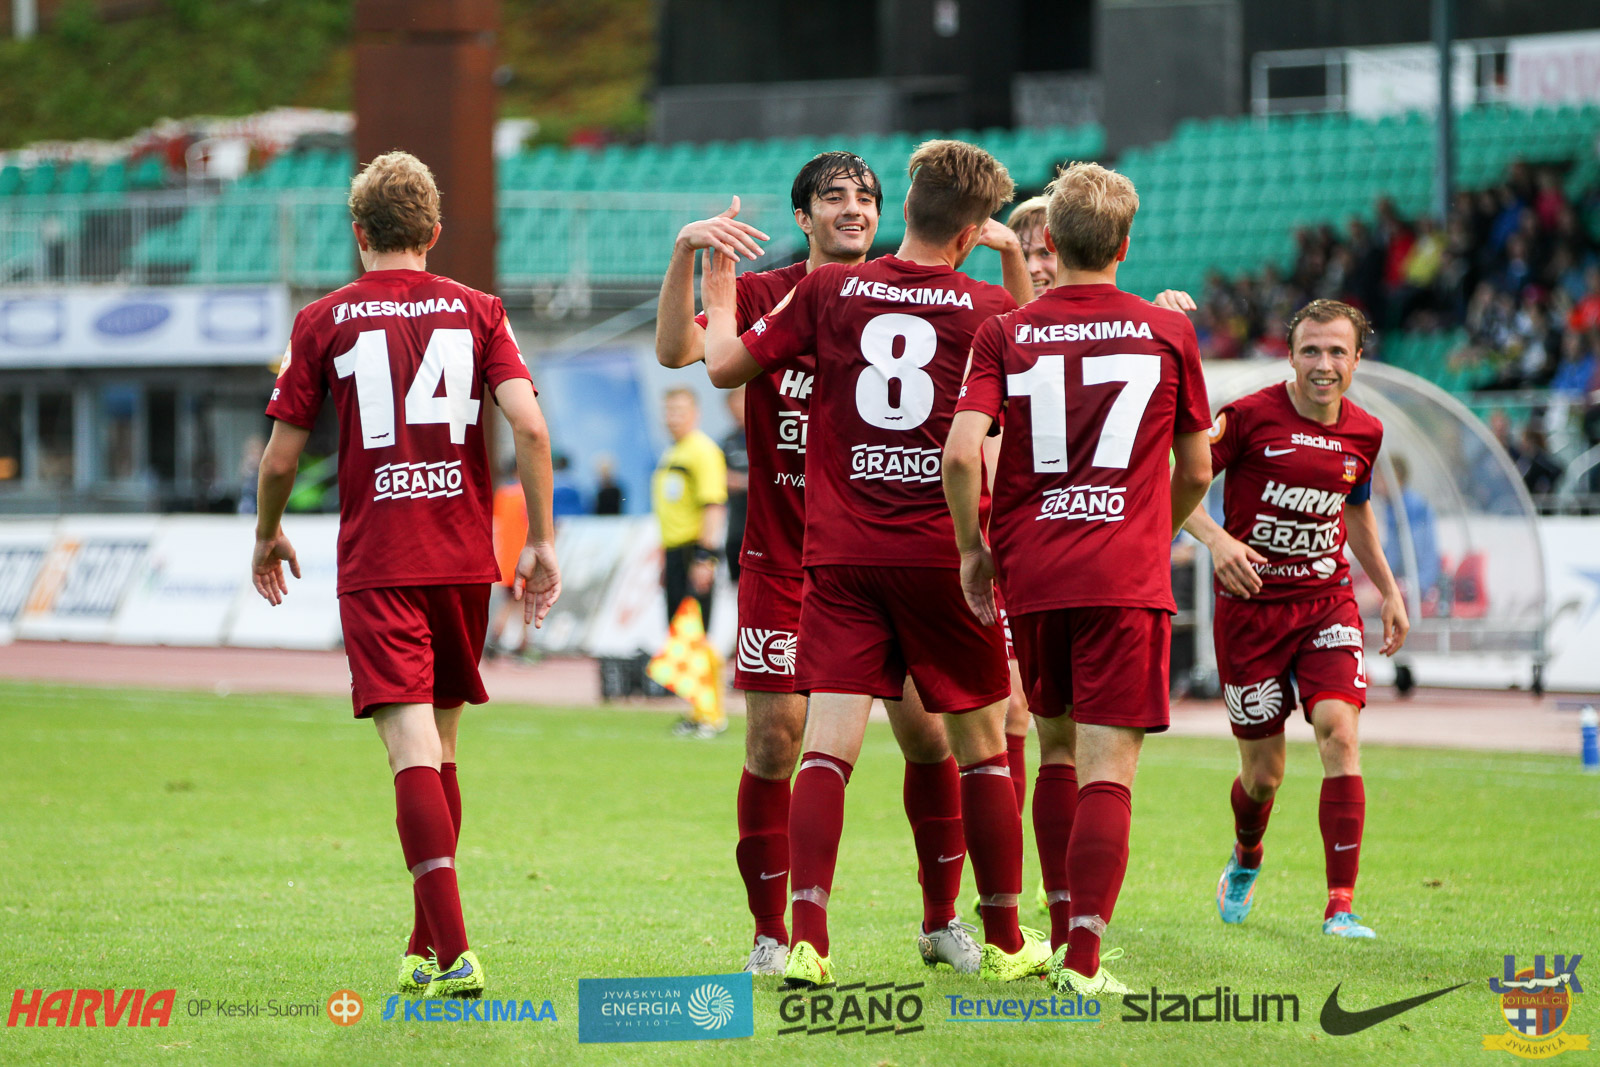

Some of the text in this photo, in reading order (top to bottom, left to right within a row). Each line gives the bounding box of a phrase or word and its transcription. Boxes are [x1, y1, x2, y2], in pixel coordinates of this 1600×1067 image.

[856, 281, 974, 310] KESKIMAA
[350, 298, 467, 318] KESKIMAA
[1033, 321, 1153, 342] KESKIMAA
[855, 313, 937, 431] 8
[333, 329, 480, 449] 14
[1007, 354, 1161, 472] 17
[1291, 432, 1342, 452] stadium
[852, 452, 940, 475] GRANO
[375, 468, 462, 492] GRANO
[1041, 493, 1125, 515] GRANO
